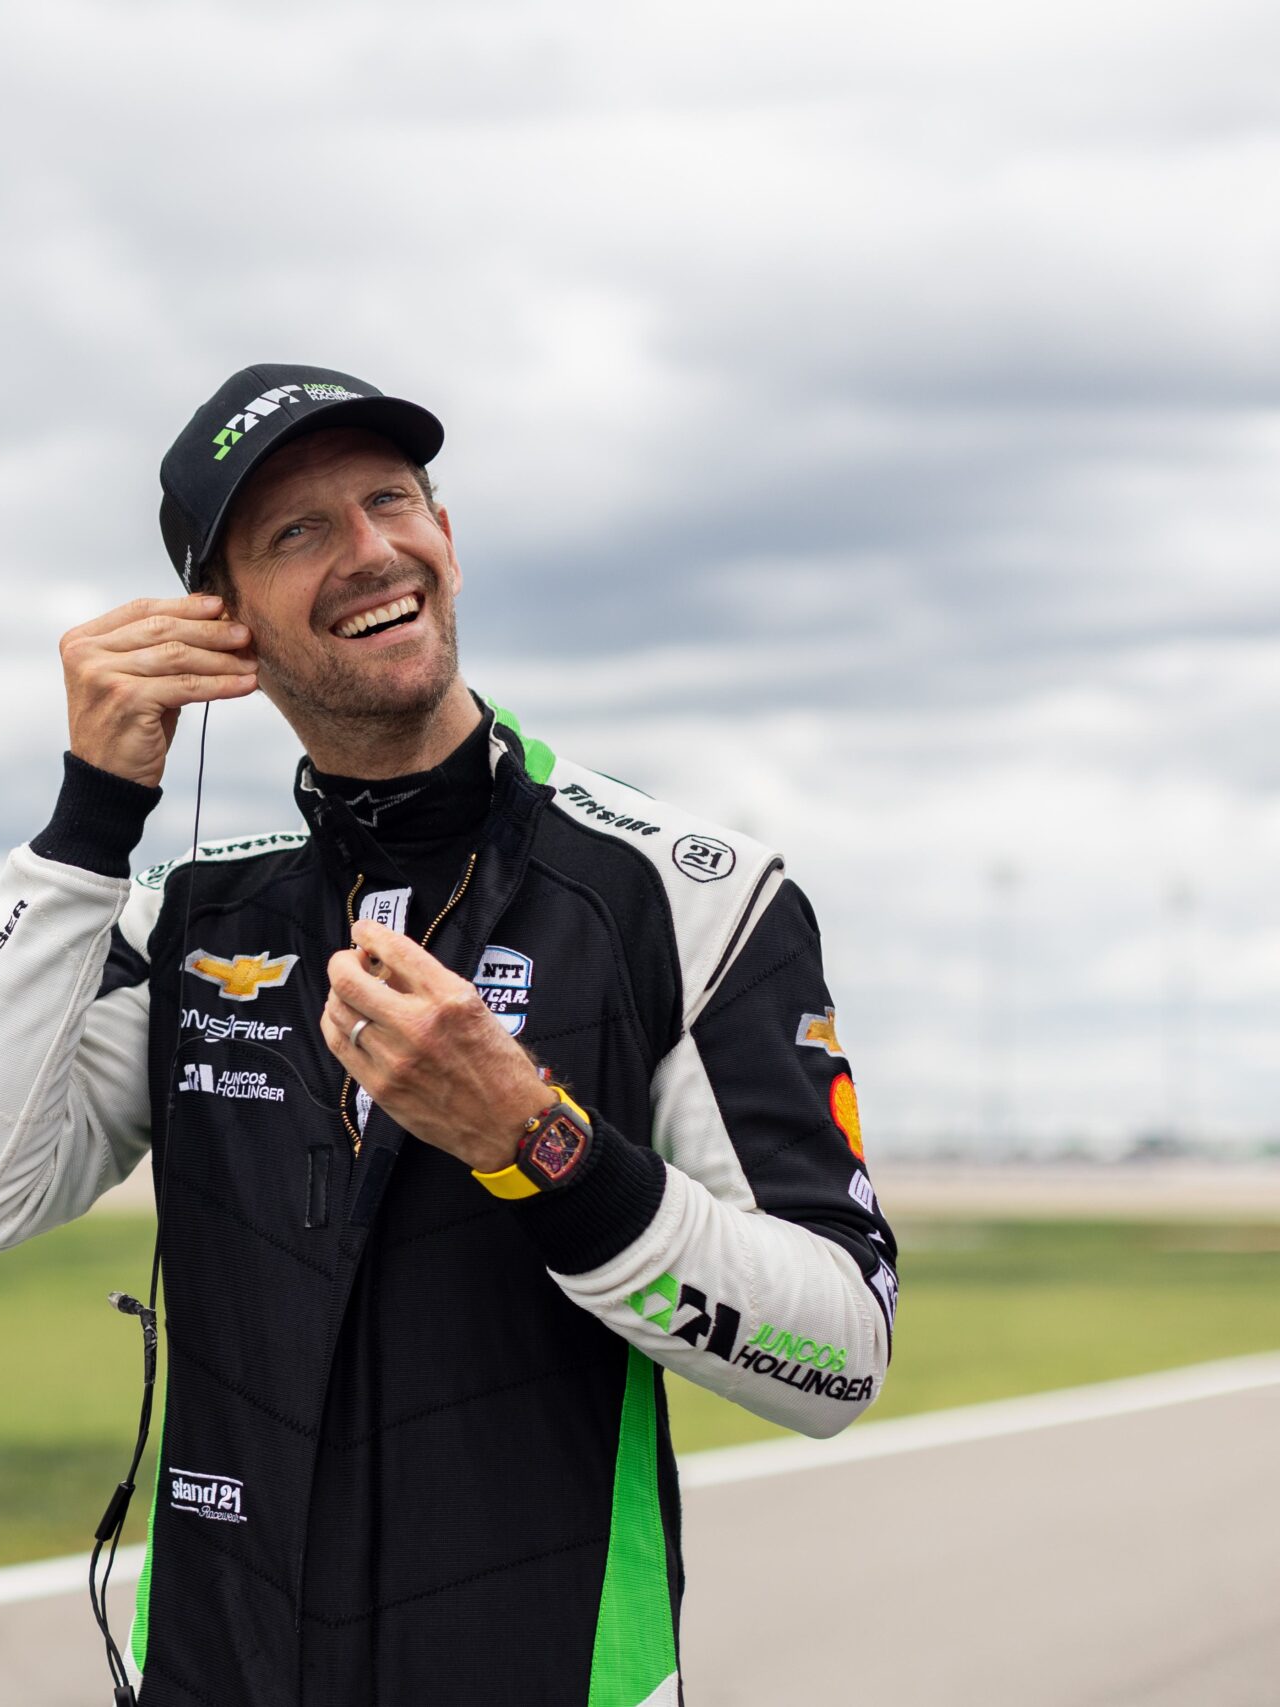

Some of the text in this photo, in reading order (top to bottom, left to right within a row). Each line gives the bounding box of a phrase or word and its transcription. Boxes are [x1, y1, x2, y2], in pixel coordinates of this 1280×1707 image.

[683, 844, 723, 870] 21
[376, 900, 392, 925] sta
[483, 963, 524, 978] NTT
[478, 988, 527, 1004] YCAR
[218, 1071, 267, 1085] JUNCOS
[216, 1083, 285, 1102] HOLLINGER
[747, 1323, 848, 1372] JUNCOS
[732, 1345, 874, 1402] HOLLINGER
[172, 1477, 241, 1513] stand 21
